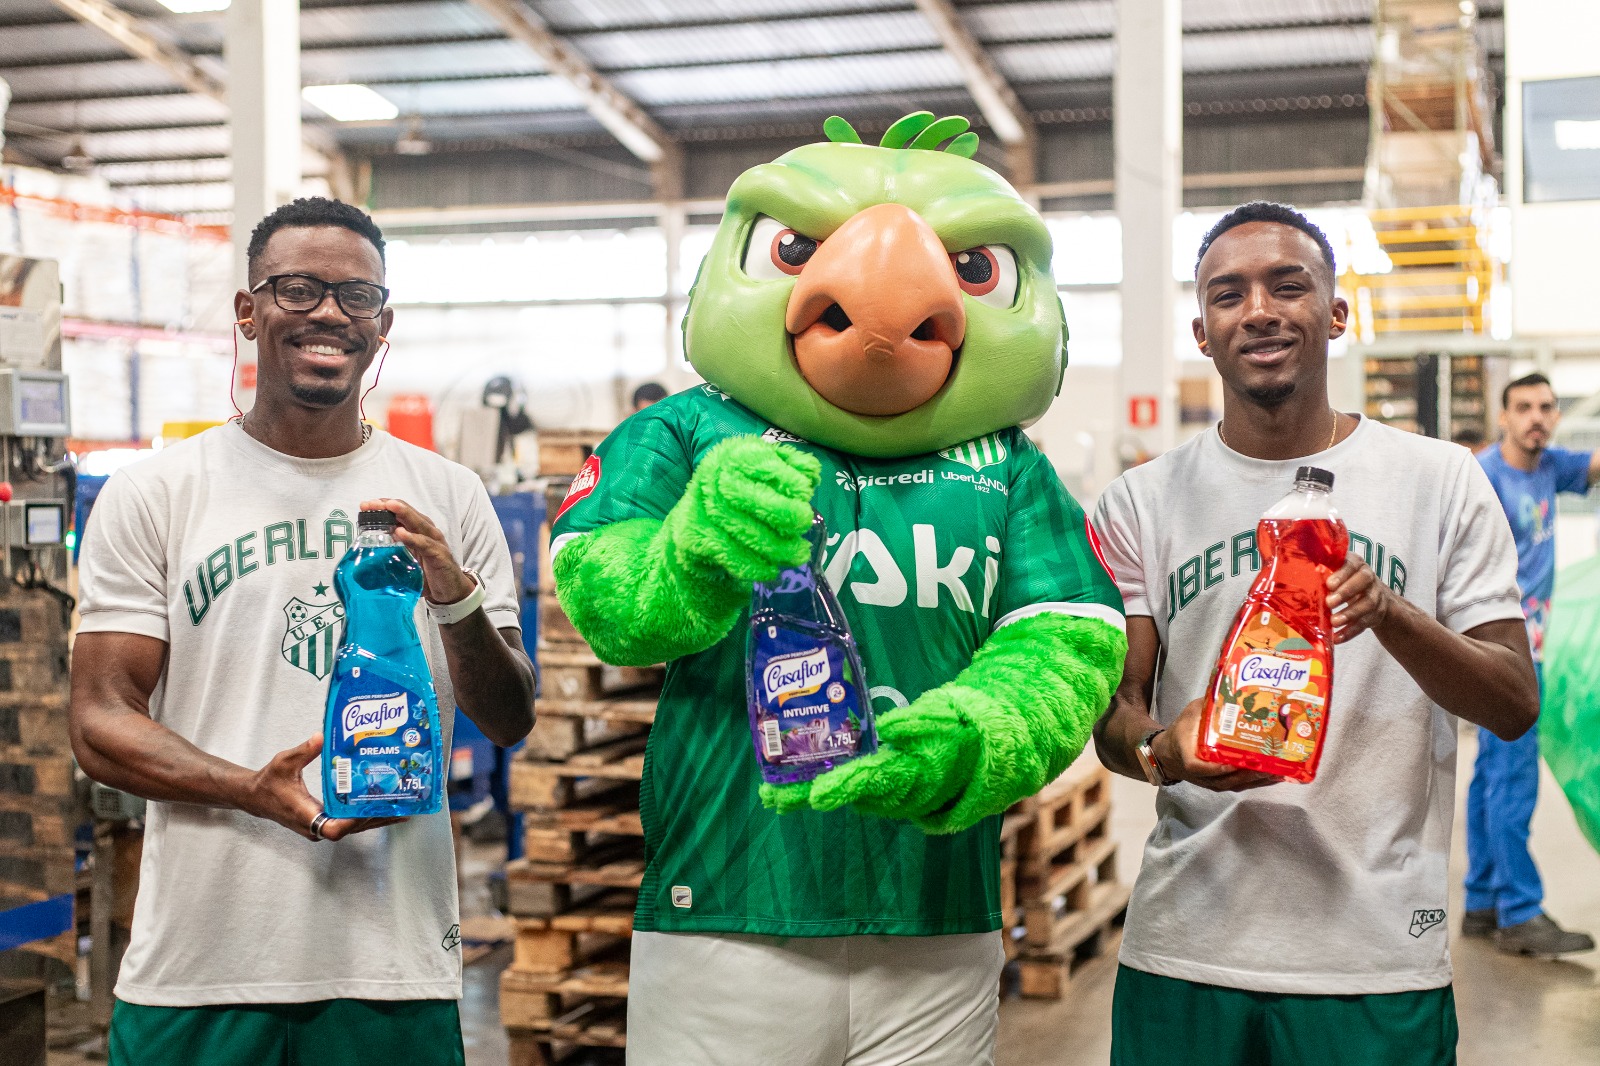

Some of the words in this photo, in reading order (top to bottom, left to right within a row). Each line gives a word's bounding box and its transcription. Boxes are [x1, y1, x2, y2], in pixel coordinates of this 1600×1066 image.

[857, 470, 934, 494] Sicredi
[974, 484, 990, 494] 1922
[183, 509, 360, 626] UBERLÂ
[767, 660, 826, 689] Casaflor
[1241, 657, 1307, 687] Casaflor
[345, 703, 404, 731] Casaflor
[783, 704, 830, 718] INTUITIVE
[1237, 721, 1261, 732] CAJU
[827, 733, 856, 748] 1,75L
[360, 746, 400, 756] DREAMS
[398, 778, 425, 791] 1,75L
